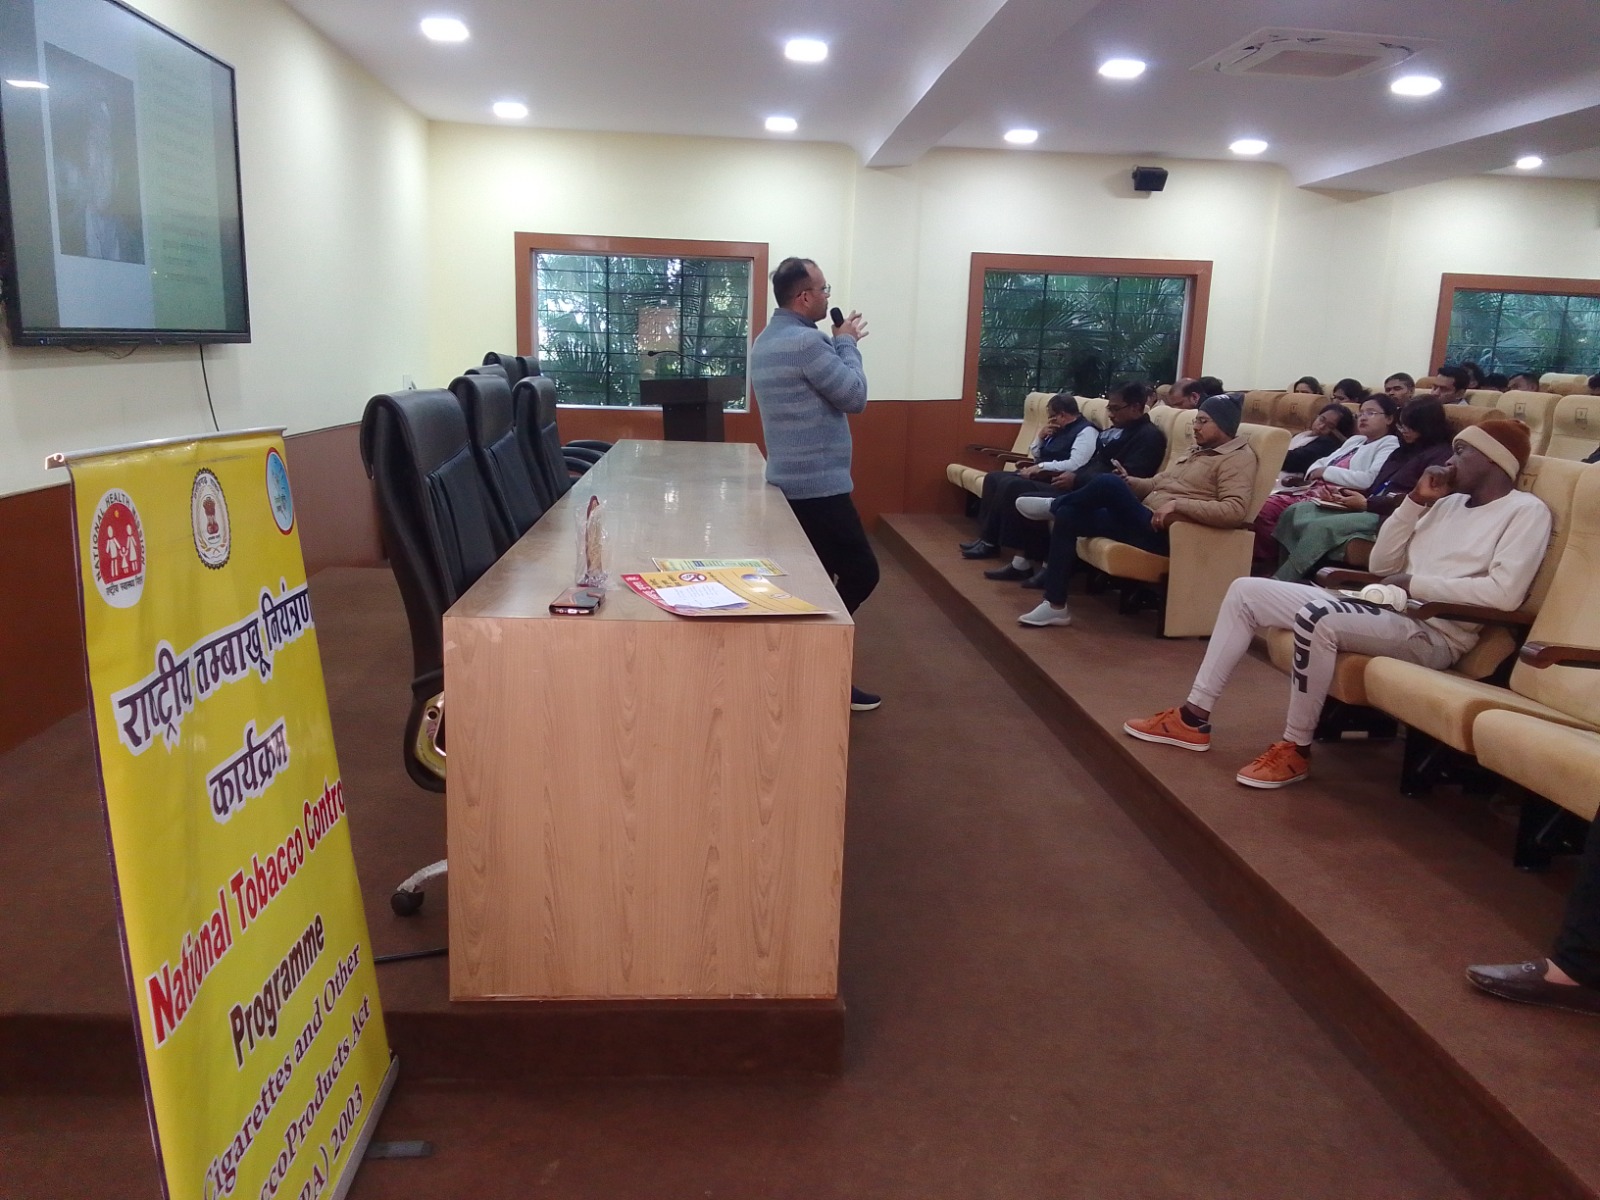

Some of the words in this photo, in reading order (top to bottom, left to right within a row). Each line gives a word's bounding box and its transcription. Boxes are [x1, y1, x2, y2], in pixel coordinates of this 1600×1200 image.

[92, 508, 105, 582] NATIONAL
[105, 492, 130, 507] HEALTH
[118, 647, 192, 748] राष्ट्रीय
[194, 617, 271, 694] तम्बाखू
[210, 723, 289, 817] कार्यक्रम
[148, 890, 232, 1045] National
[231, 827, 304, 930] Tobacco
[230, 915, 324, 1067] Programme
[294, 1000, 323, 1063] and
[324, 944, 361, 1013] Other
[352, 996, 371, 1049] Act
[330, 1083, 363, 1159] 2003
